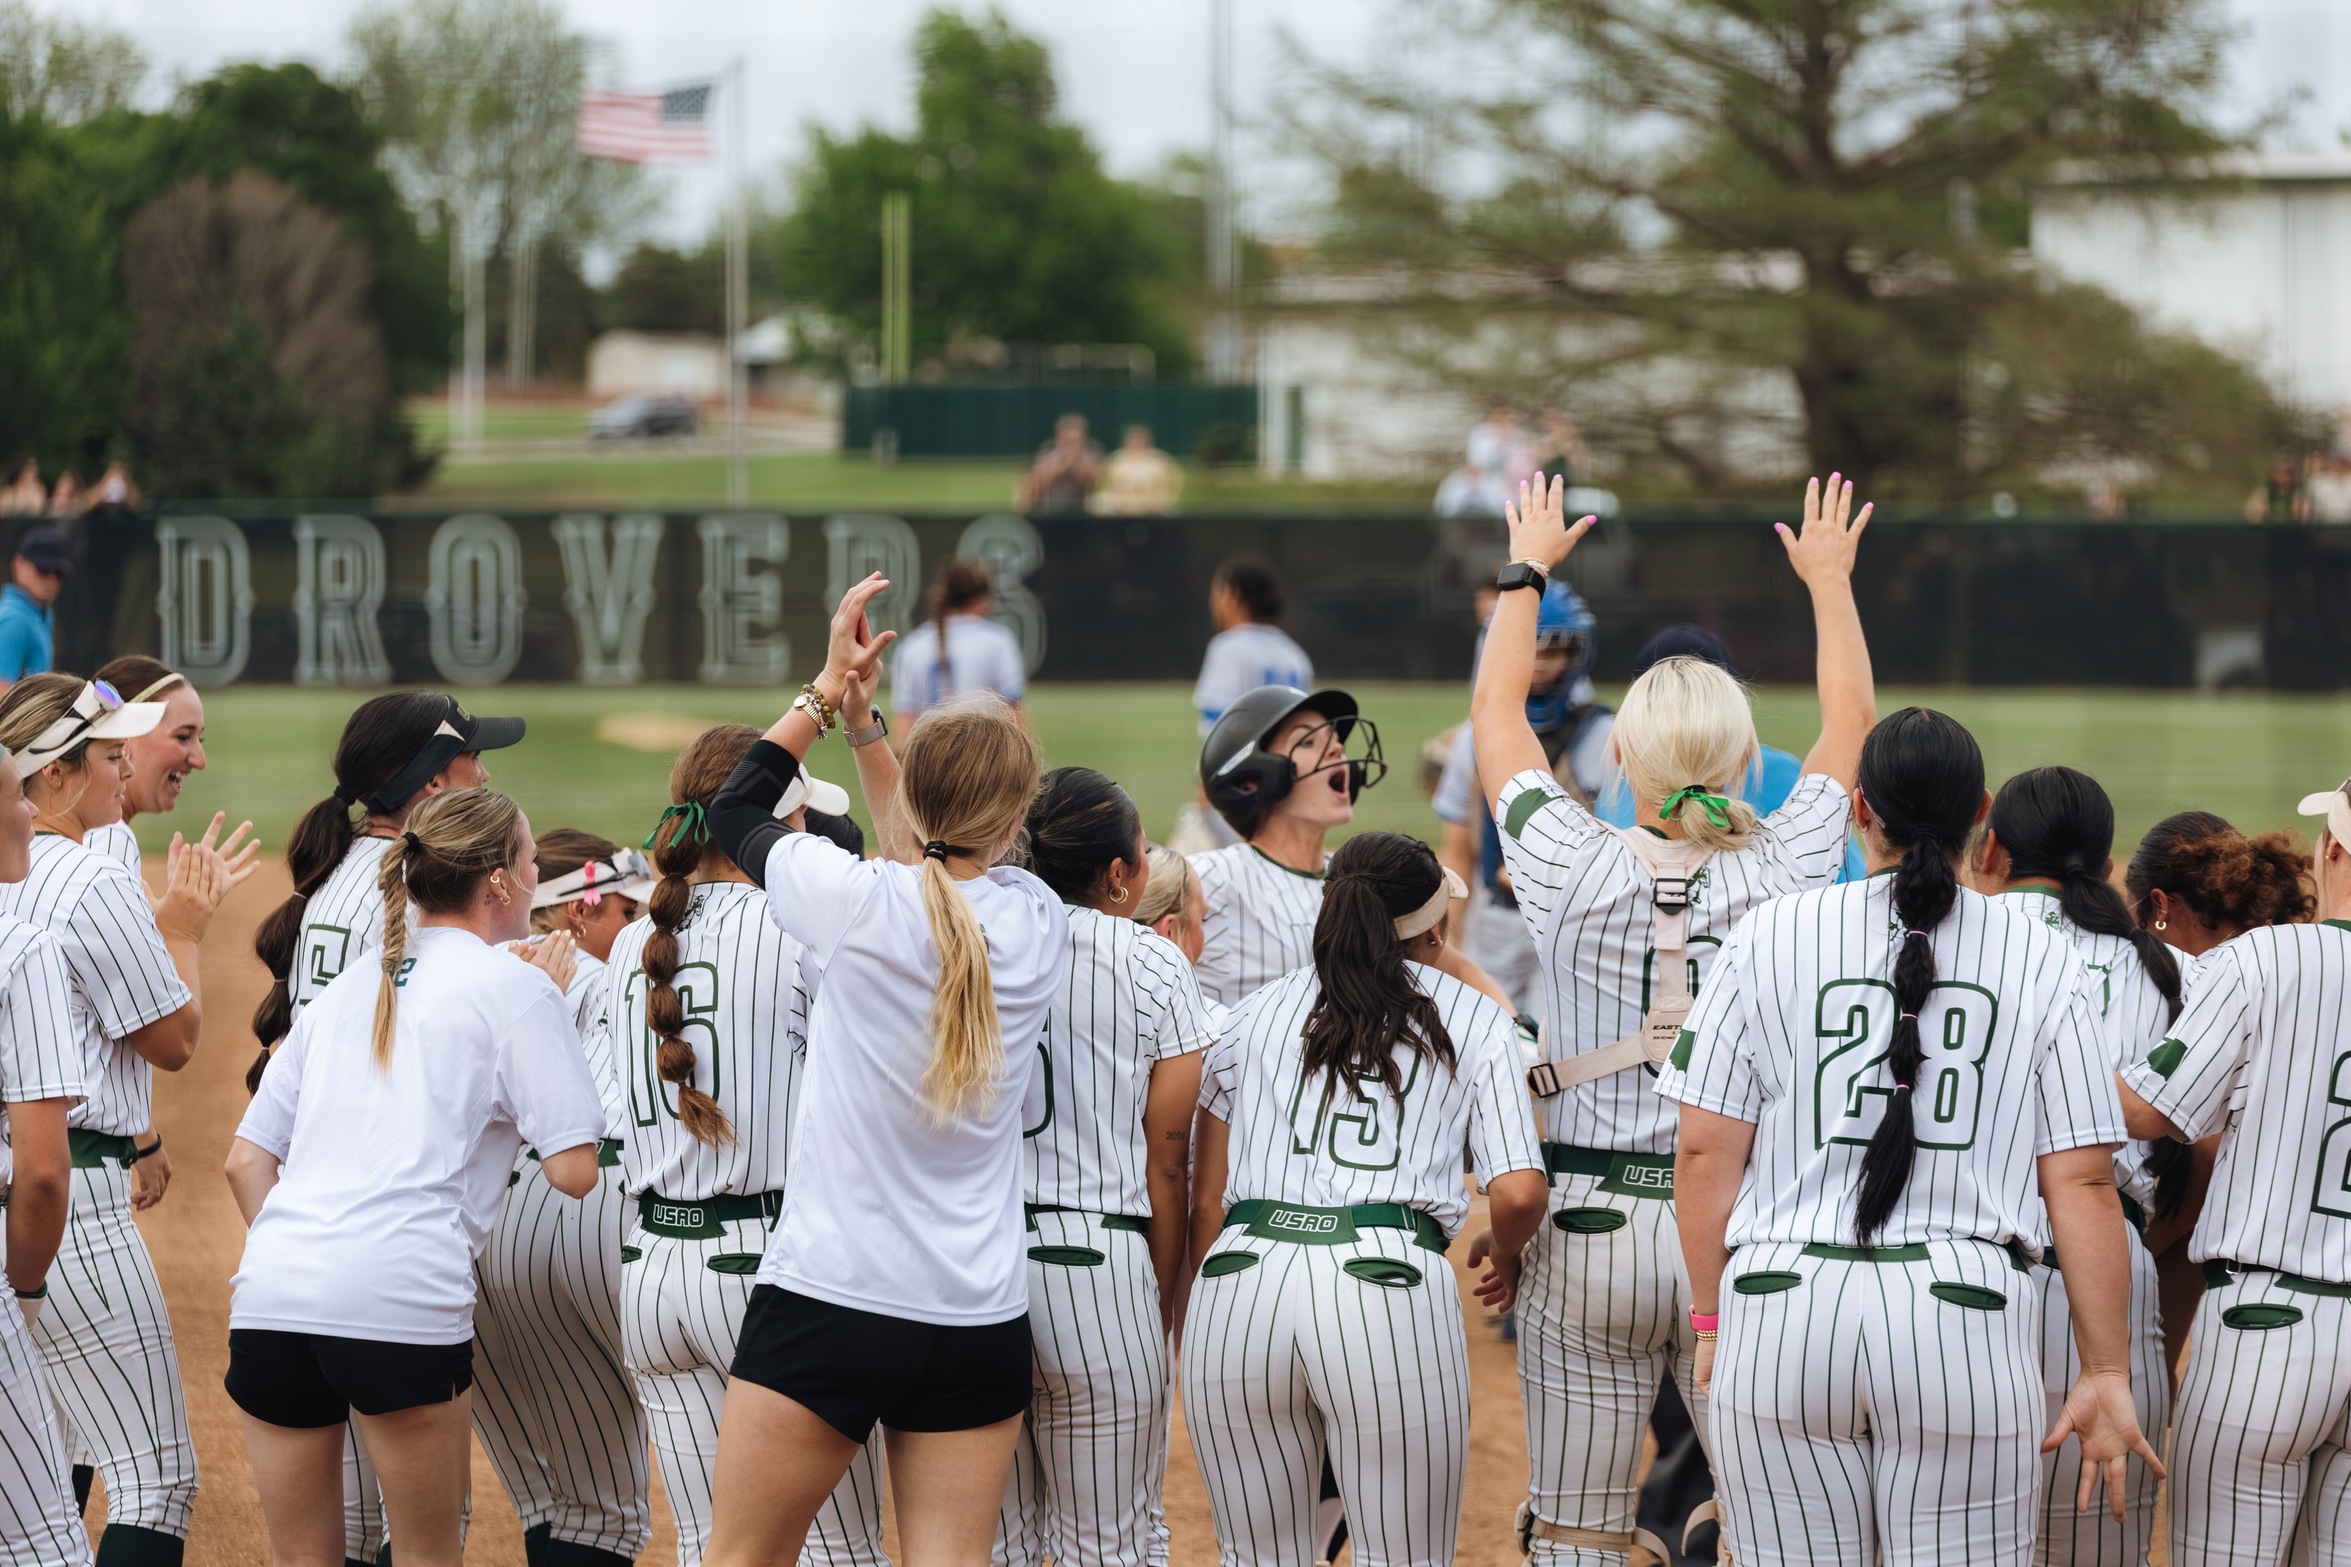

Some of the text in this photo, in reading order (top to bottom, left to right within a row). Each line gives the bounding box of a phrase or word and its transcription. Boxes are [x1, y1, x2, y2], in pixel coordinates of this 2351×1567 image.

[155, 512, 1048, 687] DROVERS
[1813, 977, 1999, 1151] 28
[1622, 1165, 1674, 1188] USA
[653, 1203, 704, 1228] USAO
[1268, 1209, 1338, 1232] USAO
